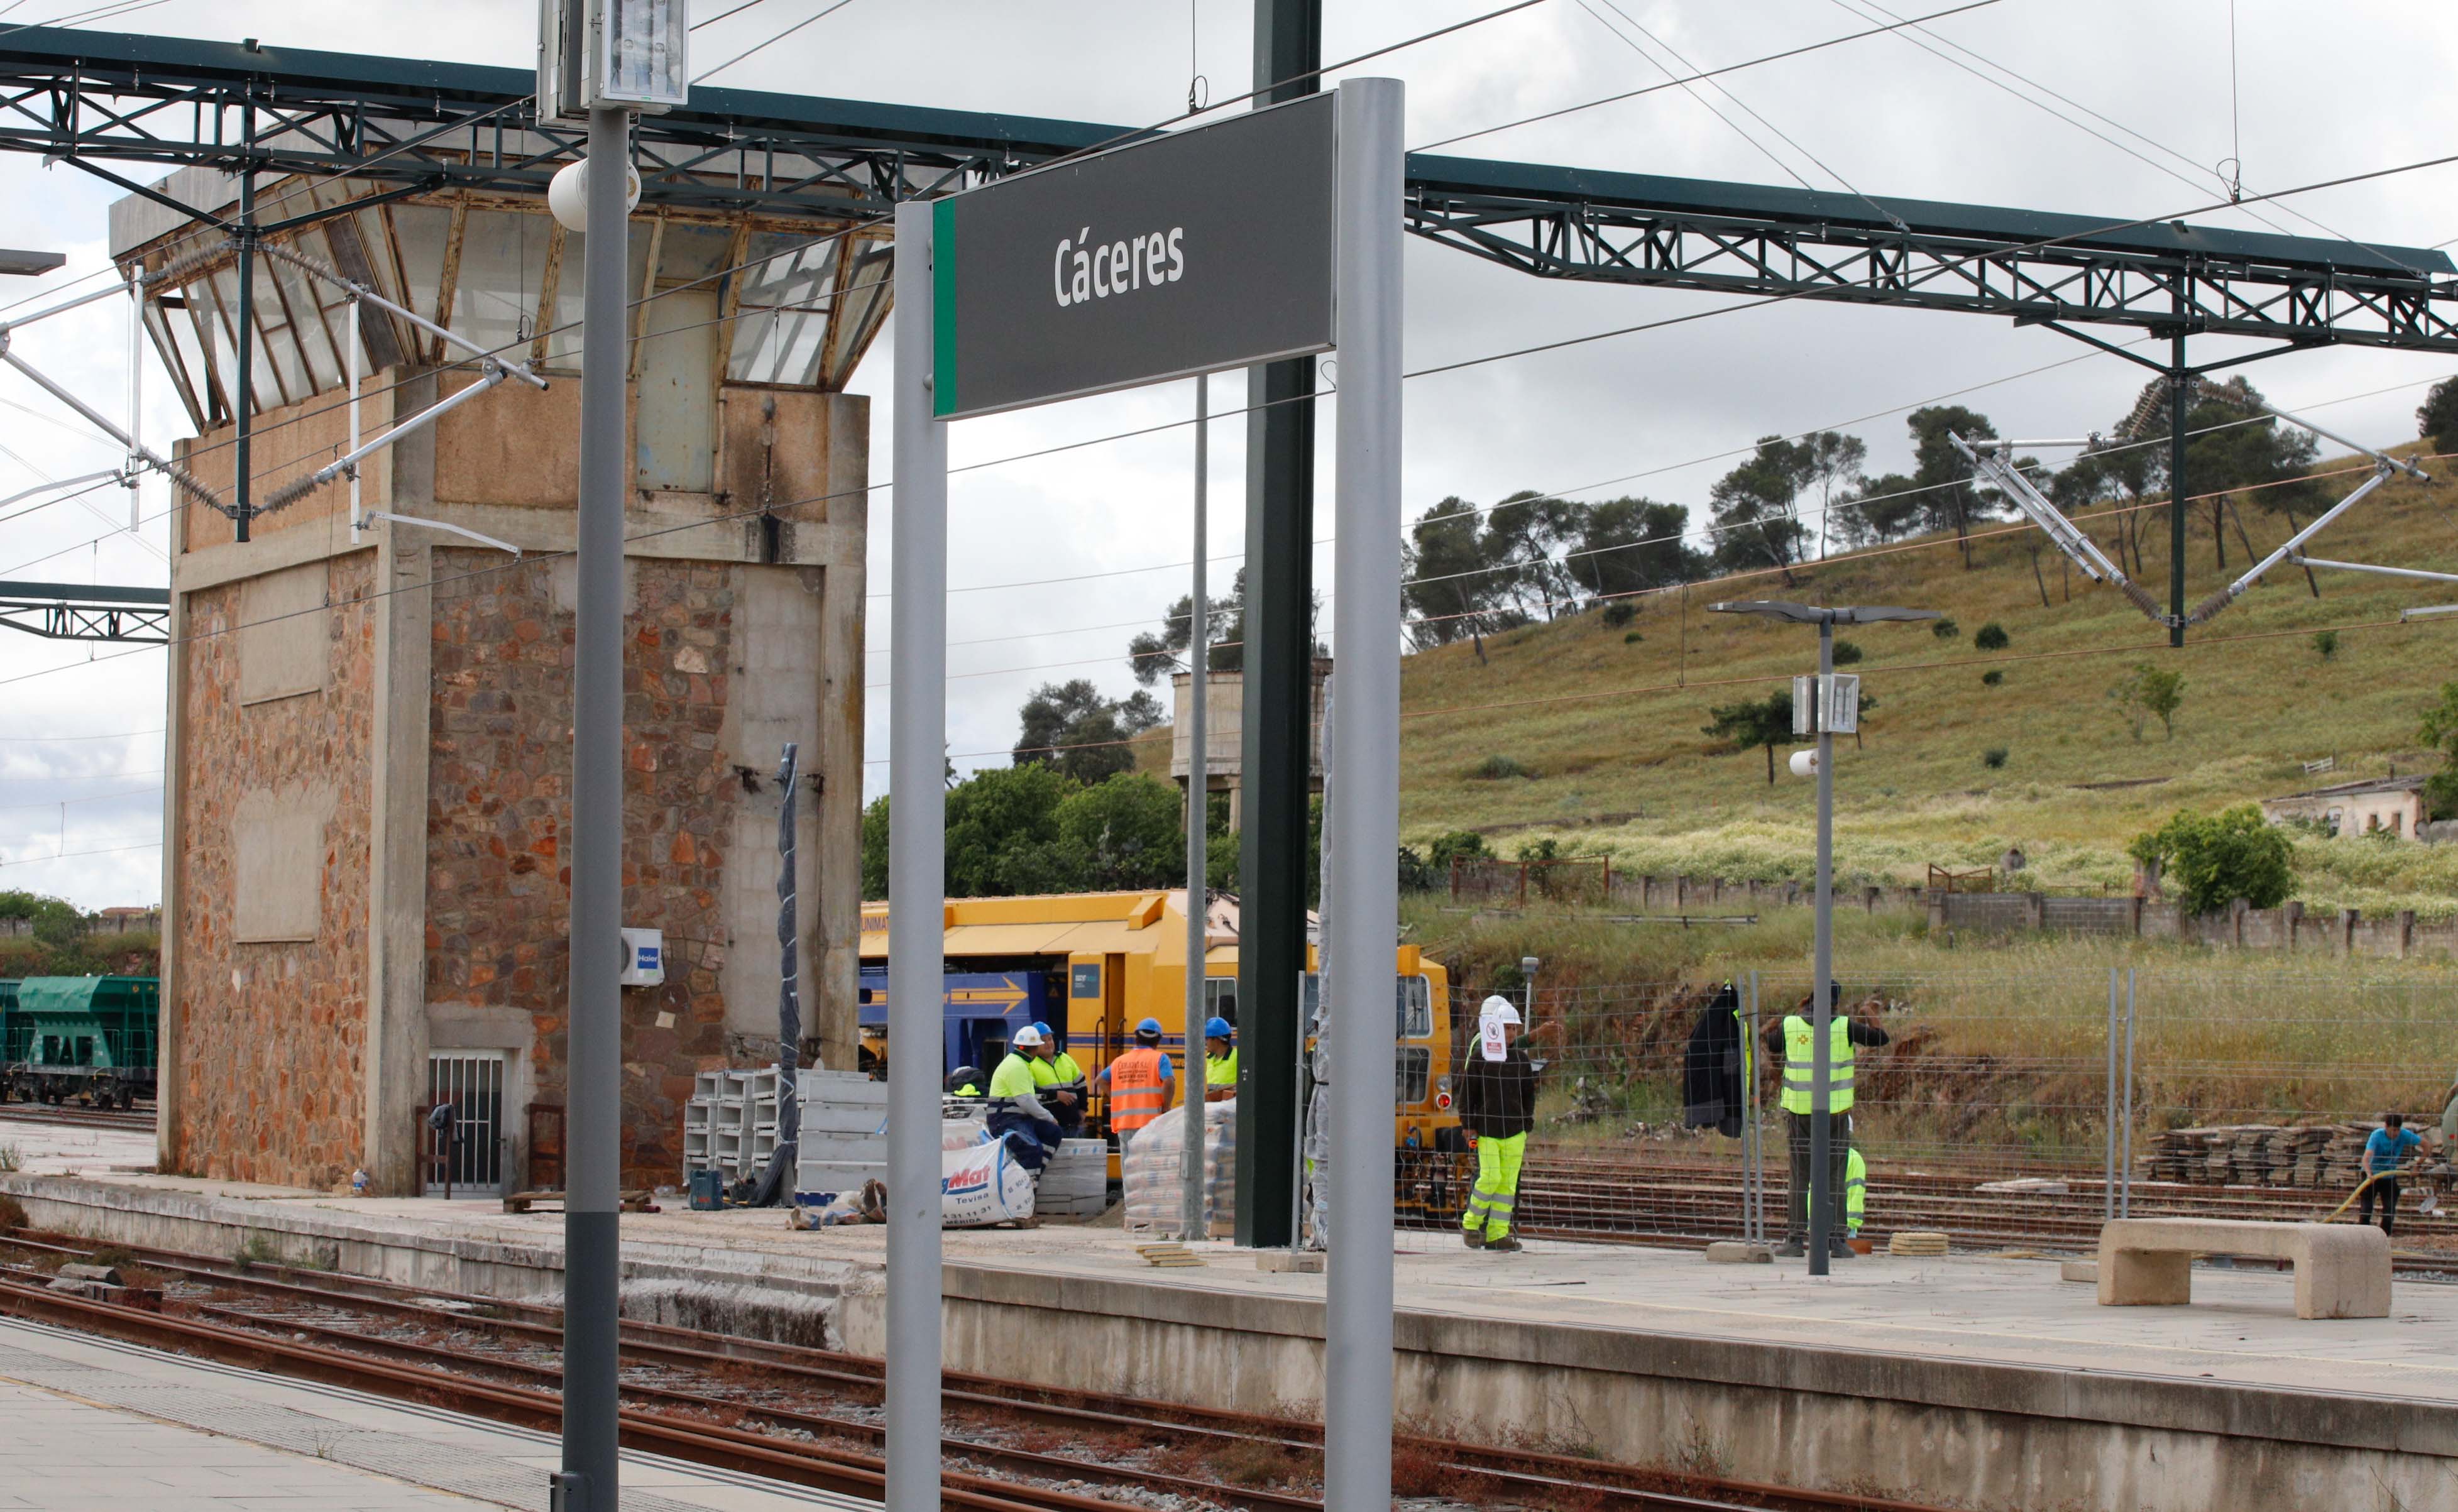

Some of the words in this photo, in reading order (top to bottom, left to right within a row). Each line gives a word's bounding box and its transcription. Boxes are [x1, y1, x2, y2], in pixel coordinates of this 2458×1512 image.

[1054, 226, 1185, 307] Cáceres
[941, 1165, 990, 1194] gMat
[955, 1193, 989, 1205] Tevisa
